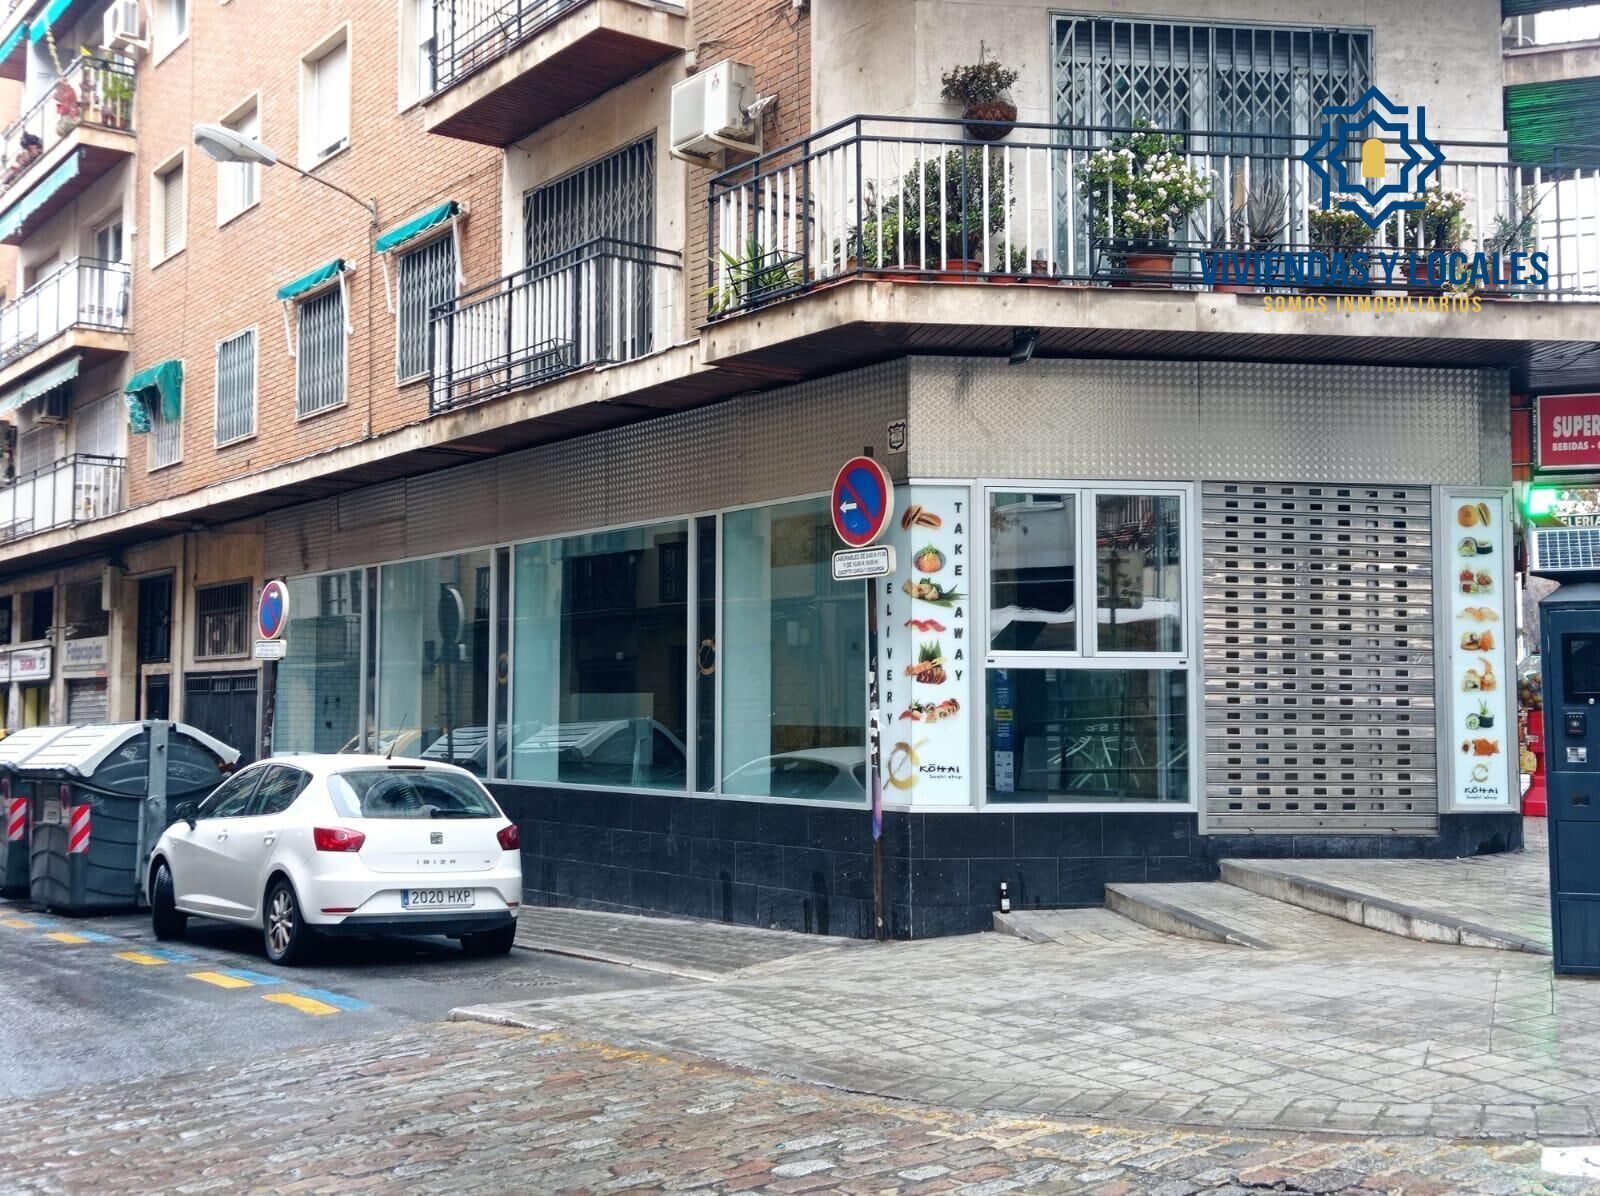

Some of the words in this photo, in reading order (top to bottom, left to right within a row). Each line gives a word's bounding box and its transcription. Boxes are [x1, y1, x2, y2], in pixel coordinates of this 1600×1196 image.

[1552, 441, 1589, 451] BEBIDAS
[954, 502, 963, 576] TAKE
[954, 606, 963, 681] AWAY
[412, 890, 444, 904] 2020
[447, 889, 471, 903] HXP
